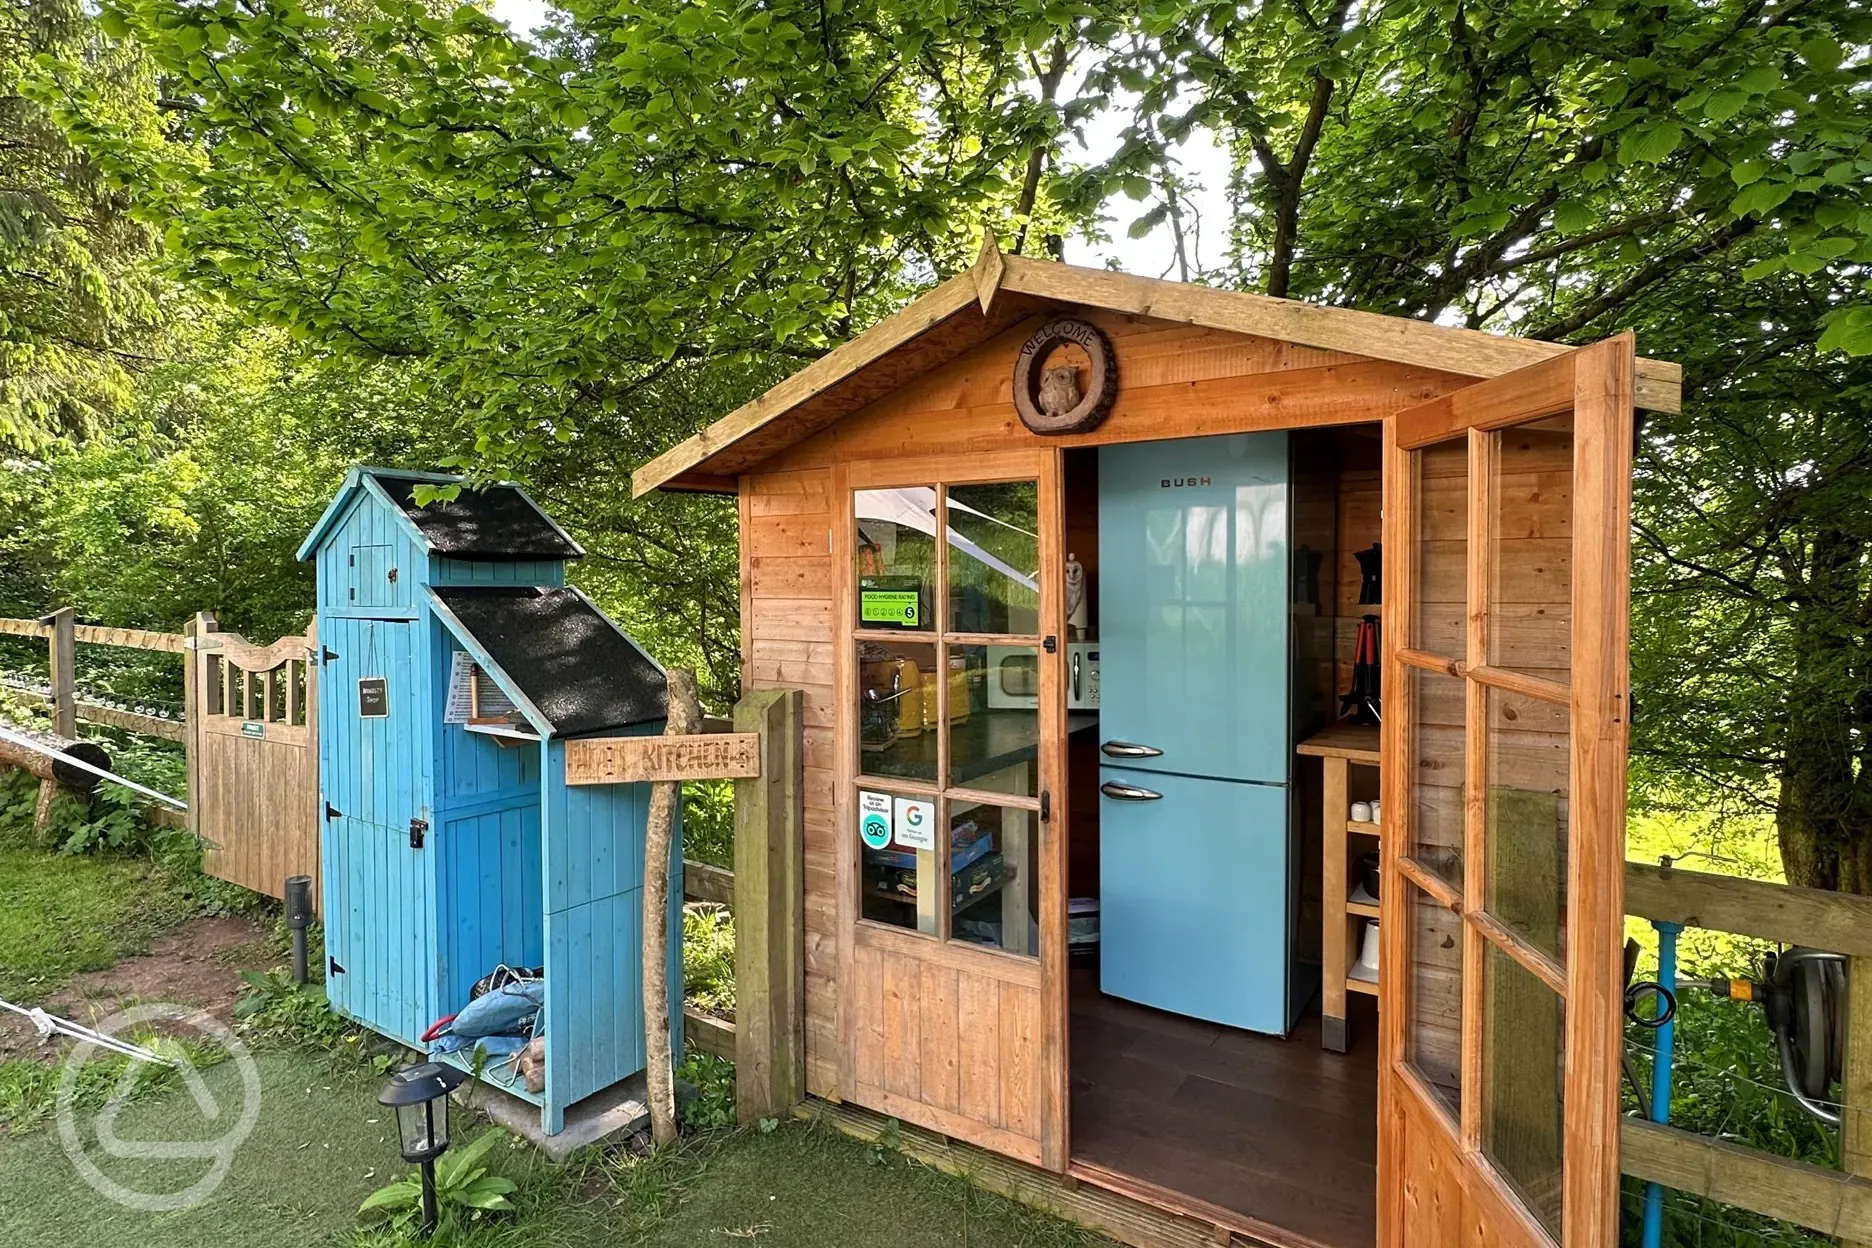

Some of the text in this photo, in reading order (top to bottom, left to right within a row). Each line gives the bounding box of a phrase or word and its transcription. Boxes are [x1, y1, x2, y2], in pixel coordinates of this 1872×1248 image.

[1022, 322, 1096, 356] WELCOME
[1161, 476, 1211, 488] BUSH
[642, 741, 731, 773] KITCHEN
[863, 804, 888, 813] Tripadvisor
[907, 806, 922, 826] G
[909, 833, 928, 843] Google
